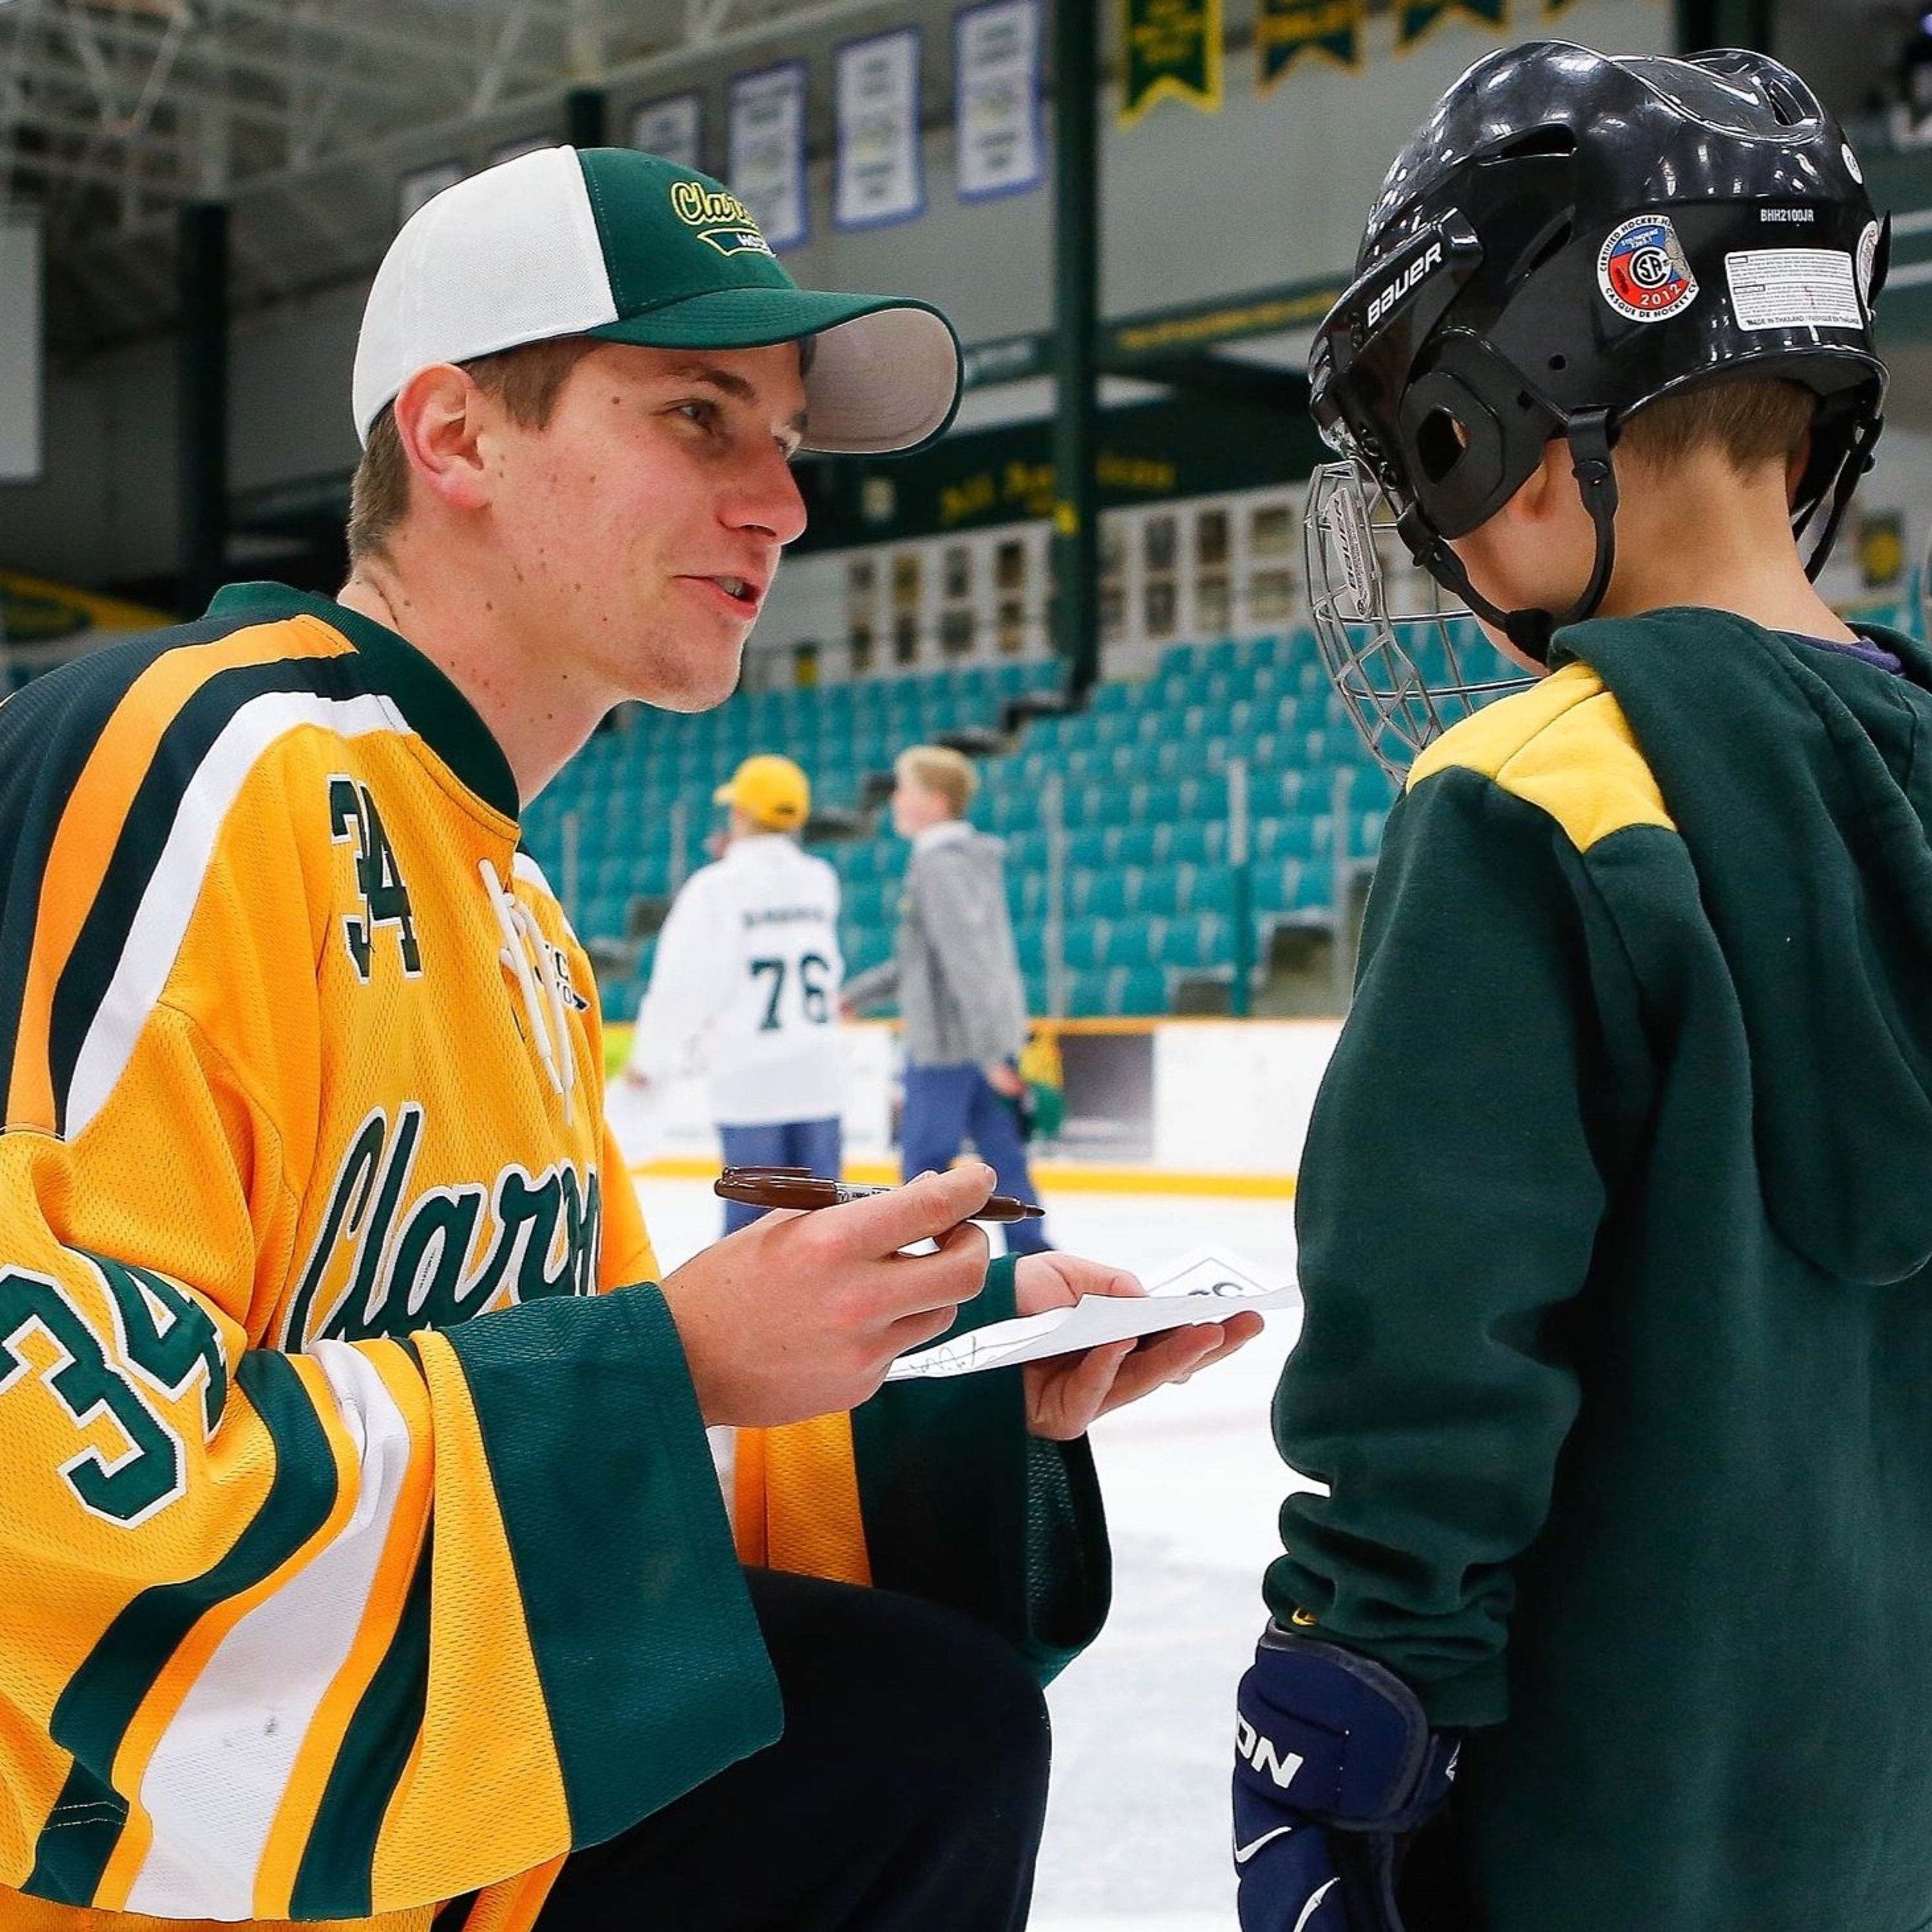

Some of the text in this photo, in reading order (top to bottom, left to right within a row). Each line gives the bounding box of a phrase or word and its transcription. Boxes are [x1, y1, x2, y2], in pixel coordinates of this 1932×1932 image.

[670, 181, 756, 226] Clar
[1760, 209, 1814, 222] BHH2100JR
[1600, 232, 1620, 272] CERTIFIED
[1621, 217, 1658, 232] HOCKEY
[1367, 242, 1442, 328] BAUER
[1605, 288, 1690, 318] CASQUE DE HOCKEY
[1641, 284, 1681, 306] 2012
[327, 775, 422, 985] 34
[749, 952, 830, 1032] 76
[0, 1244, 229, 1530] 34
